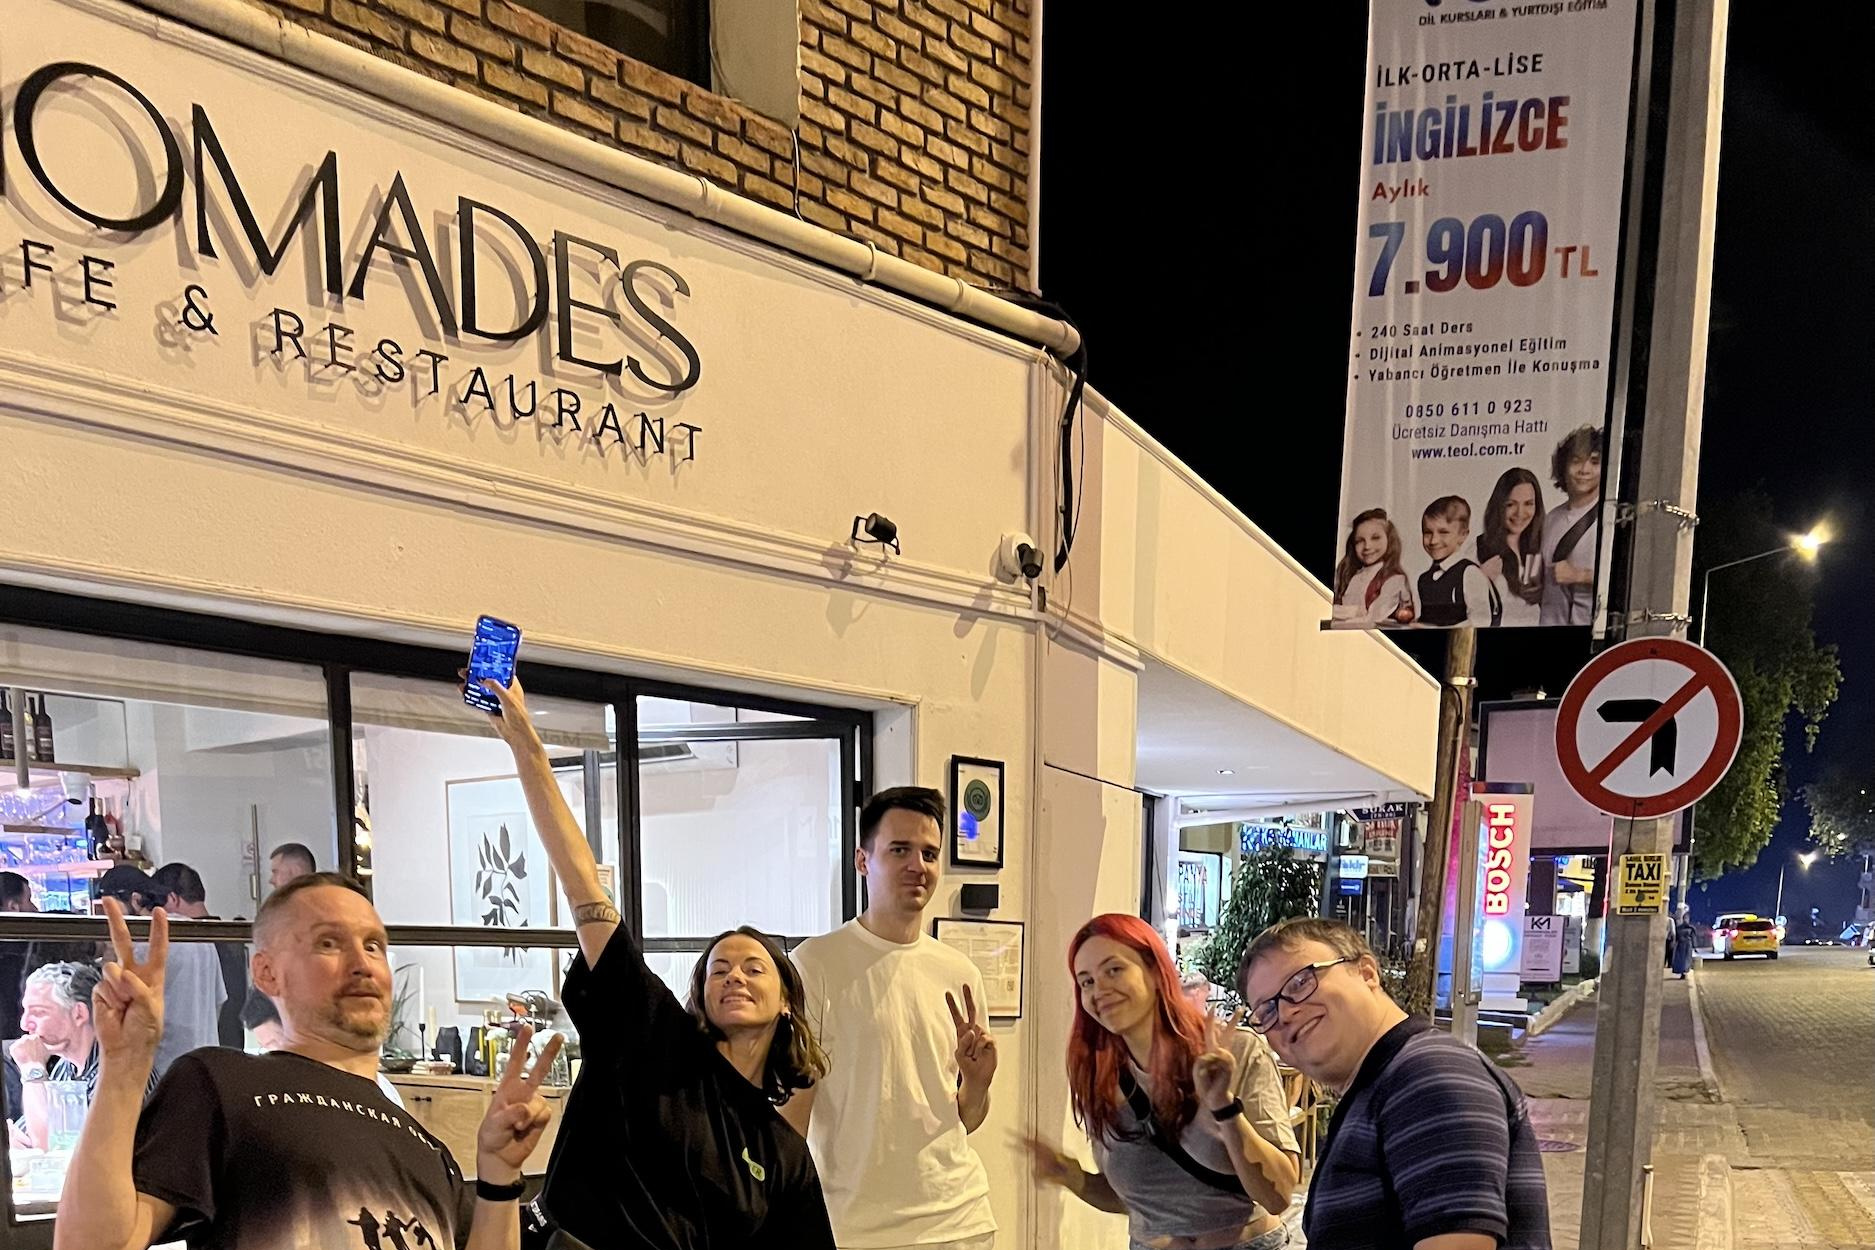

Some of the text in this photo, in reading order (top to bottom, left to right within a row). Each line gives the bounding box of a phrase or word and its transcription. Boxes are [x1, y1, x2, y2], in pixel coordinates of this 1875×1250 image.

[1419, 15, 1436, 26] DİL
[1440, 9, 1495, 24] KURSLARI
[1376, 51, 1544, 88] İLK-ORTA-LİSE
[1372, 91, 1571, 165] İNGİLİZCE
[1371, 178, 1430, 202] Aylık
[0, 61, 701, 392] OMADES
[1367, 210, 1599, 298] 7.900 TL
[1371, 321, 1474, 339] 240 Saat Ders
[1369, 337, 1567, 362] Dijital Animasyonel Eğitim
[182, 284, 218, 336] &
[271, 308, 702, 462] RESTAURANT
[1368, 365, 1425, 383] Yabancı
[1431, 361, 1502, 381] Öğretmen
[1532, 357, 1601, 375] Konuşma
[1405, 399, 1533, 419] 0850 611 0 923
[1391, 418, 1549, 442] Ücretsiz Danışma Hattı
[1411, 441, 1526, 461] www.teol.com.tr
[1486, 803, 1515, 914] BOSCH
[1626, 863, 1661, 881] TAXI
[253, 1091, 402, 1129] ГРАЖДАНСКАЯ
